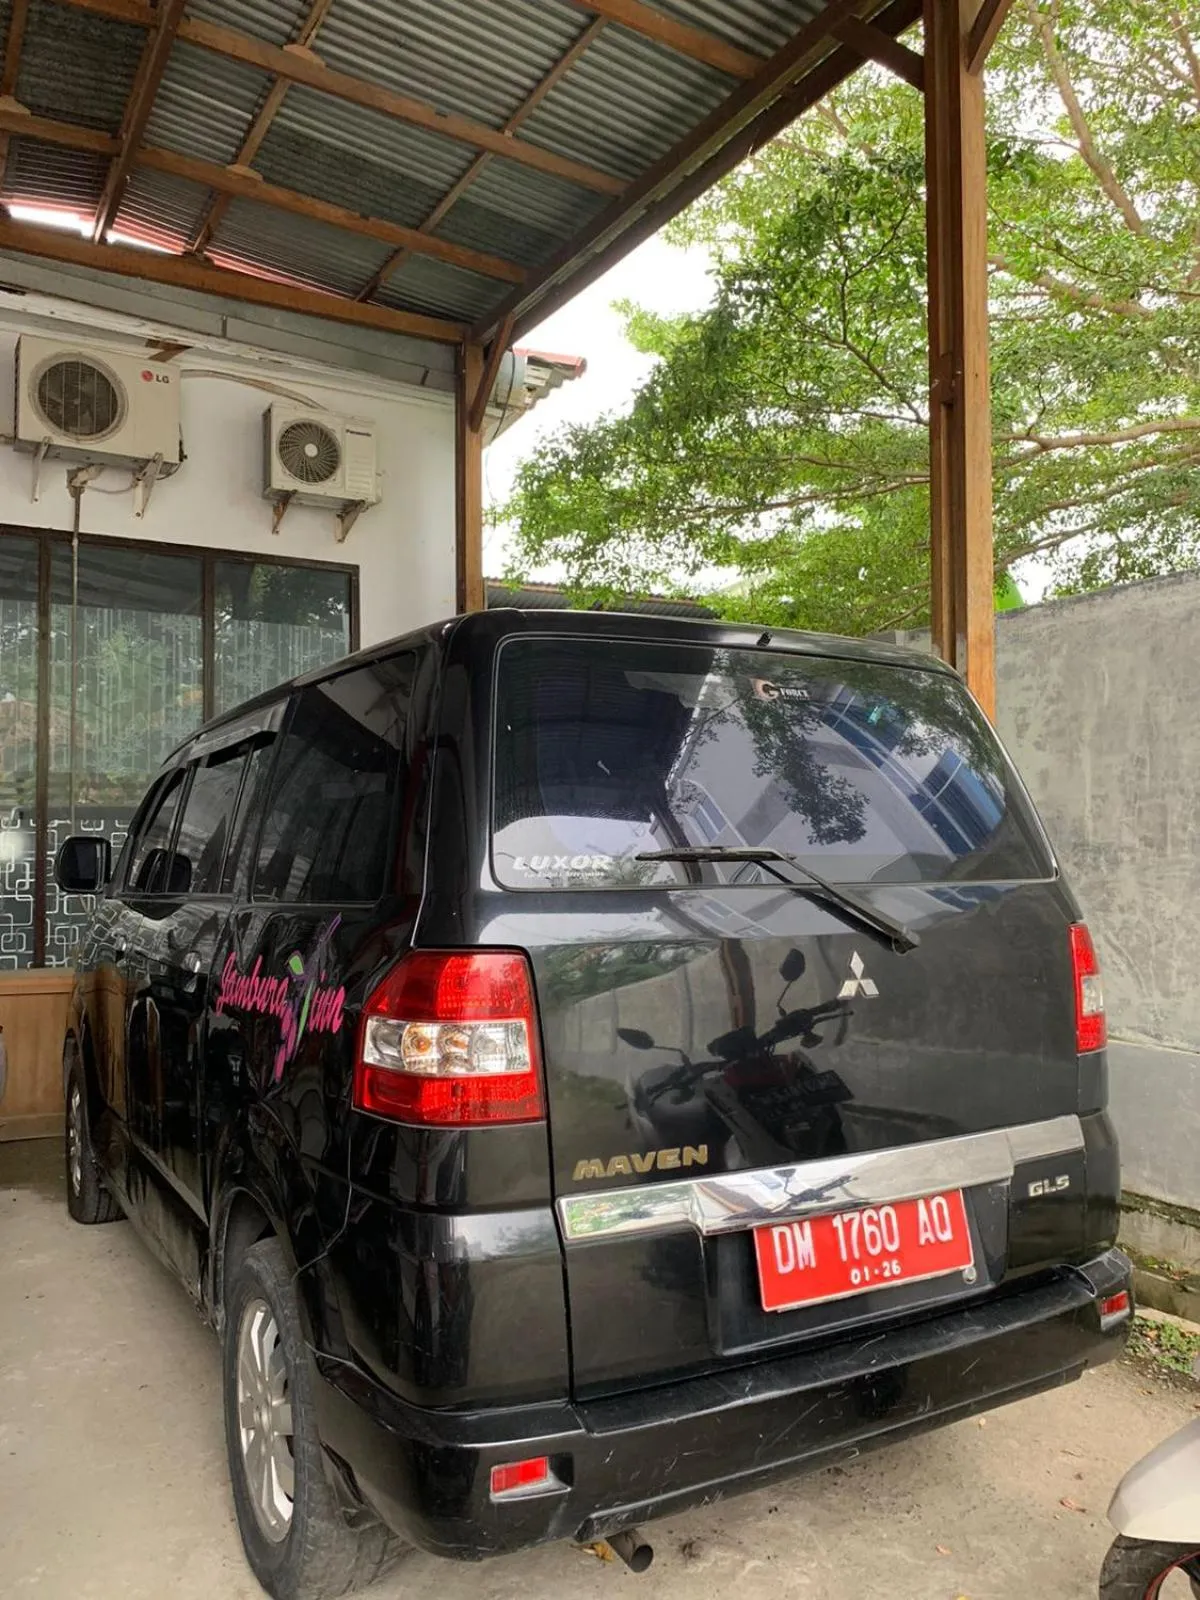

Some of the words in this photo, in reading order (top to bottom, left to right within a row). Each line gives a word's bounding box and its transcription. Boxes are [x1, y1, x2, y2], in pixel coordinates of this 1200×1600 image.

[512, 855, 613, 870] LUXOR
[572, 1144, 708, 1181] MAVEN
[1028, 1175, 1070, 1197] GLS
[771, 1221, 816, 1275] DM
[832, 1206, 900, 1262] 1760
[917, 1196, 953, 1246] AQ
